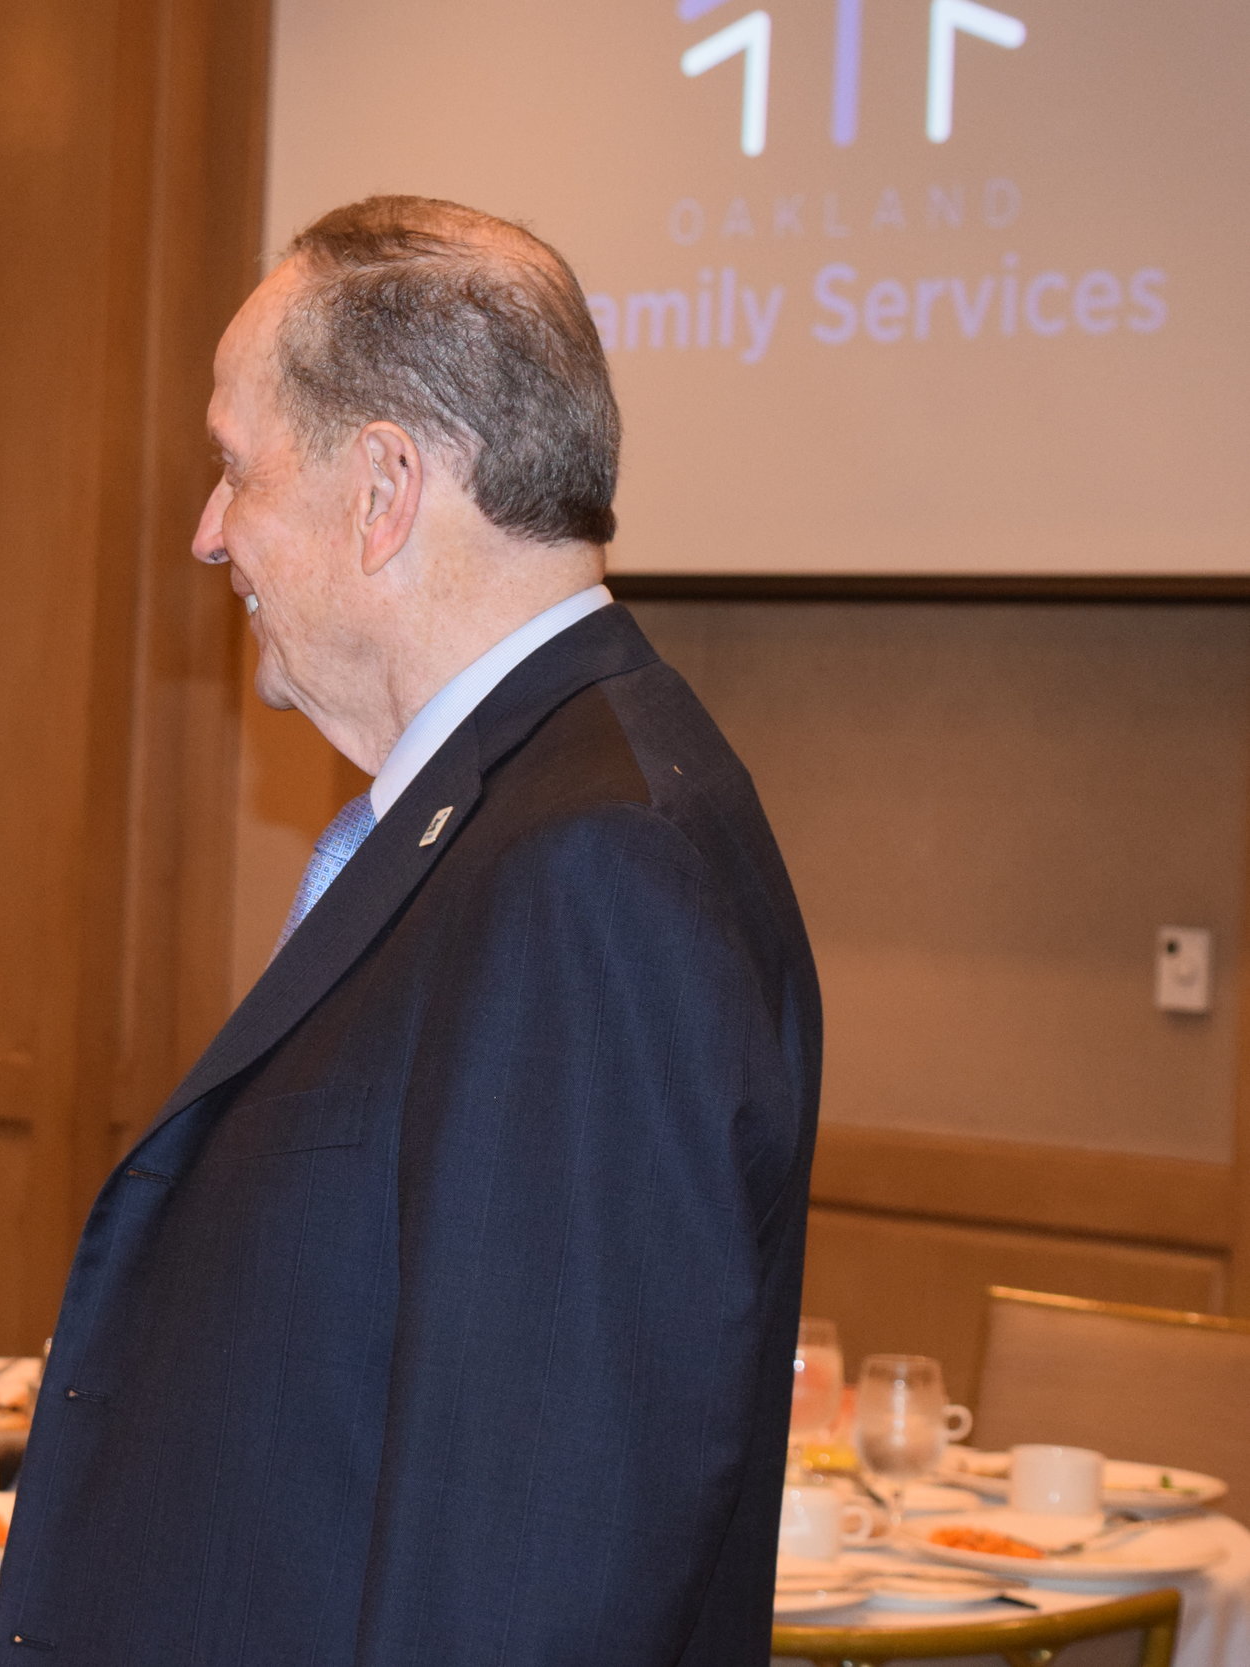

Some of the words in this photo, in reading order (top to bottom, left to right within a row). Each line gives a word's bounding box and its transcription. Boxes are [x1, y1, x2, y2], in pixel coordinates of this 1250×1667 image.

[667, 178, 1022, 246] OAKLAND
[586, 266, 784, 364] amily
[811, 252, 1169, 345] Services
